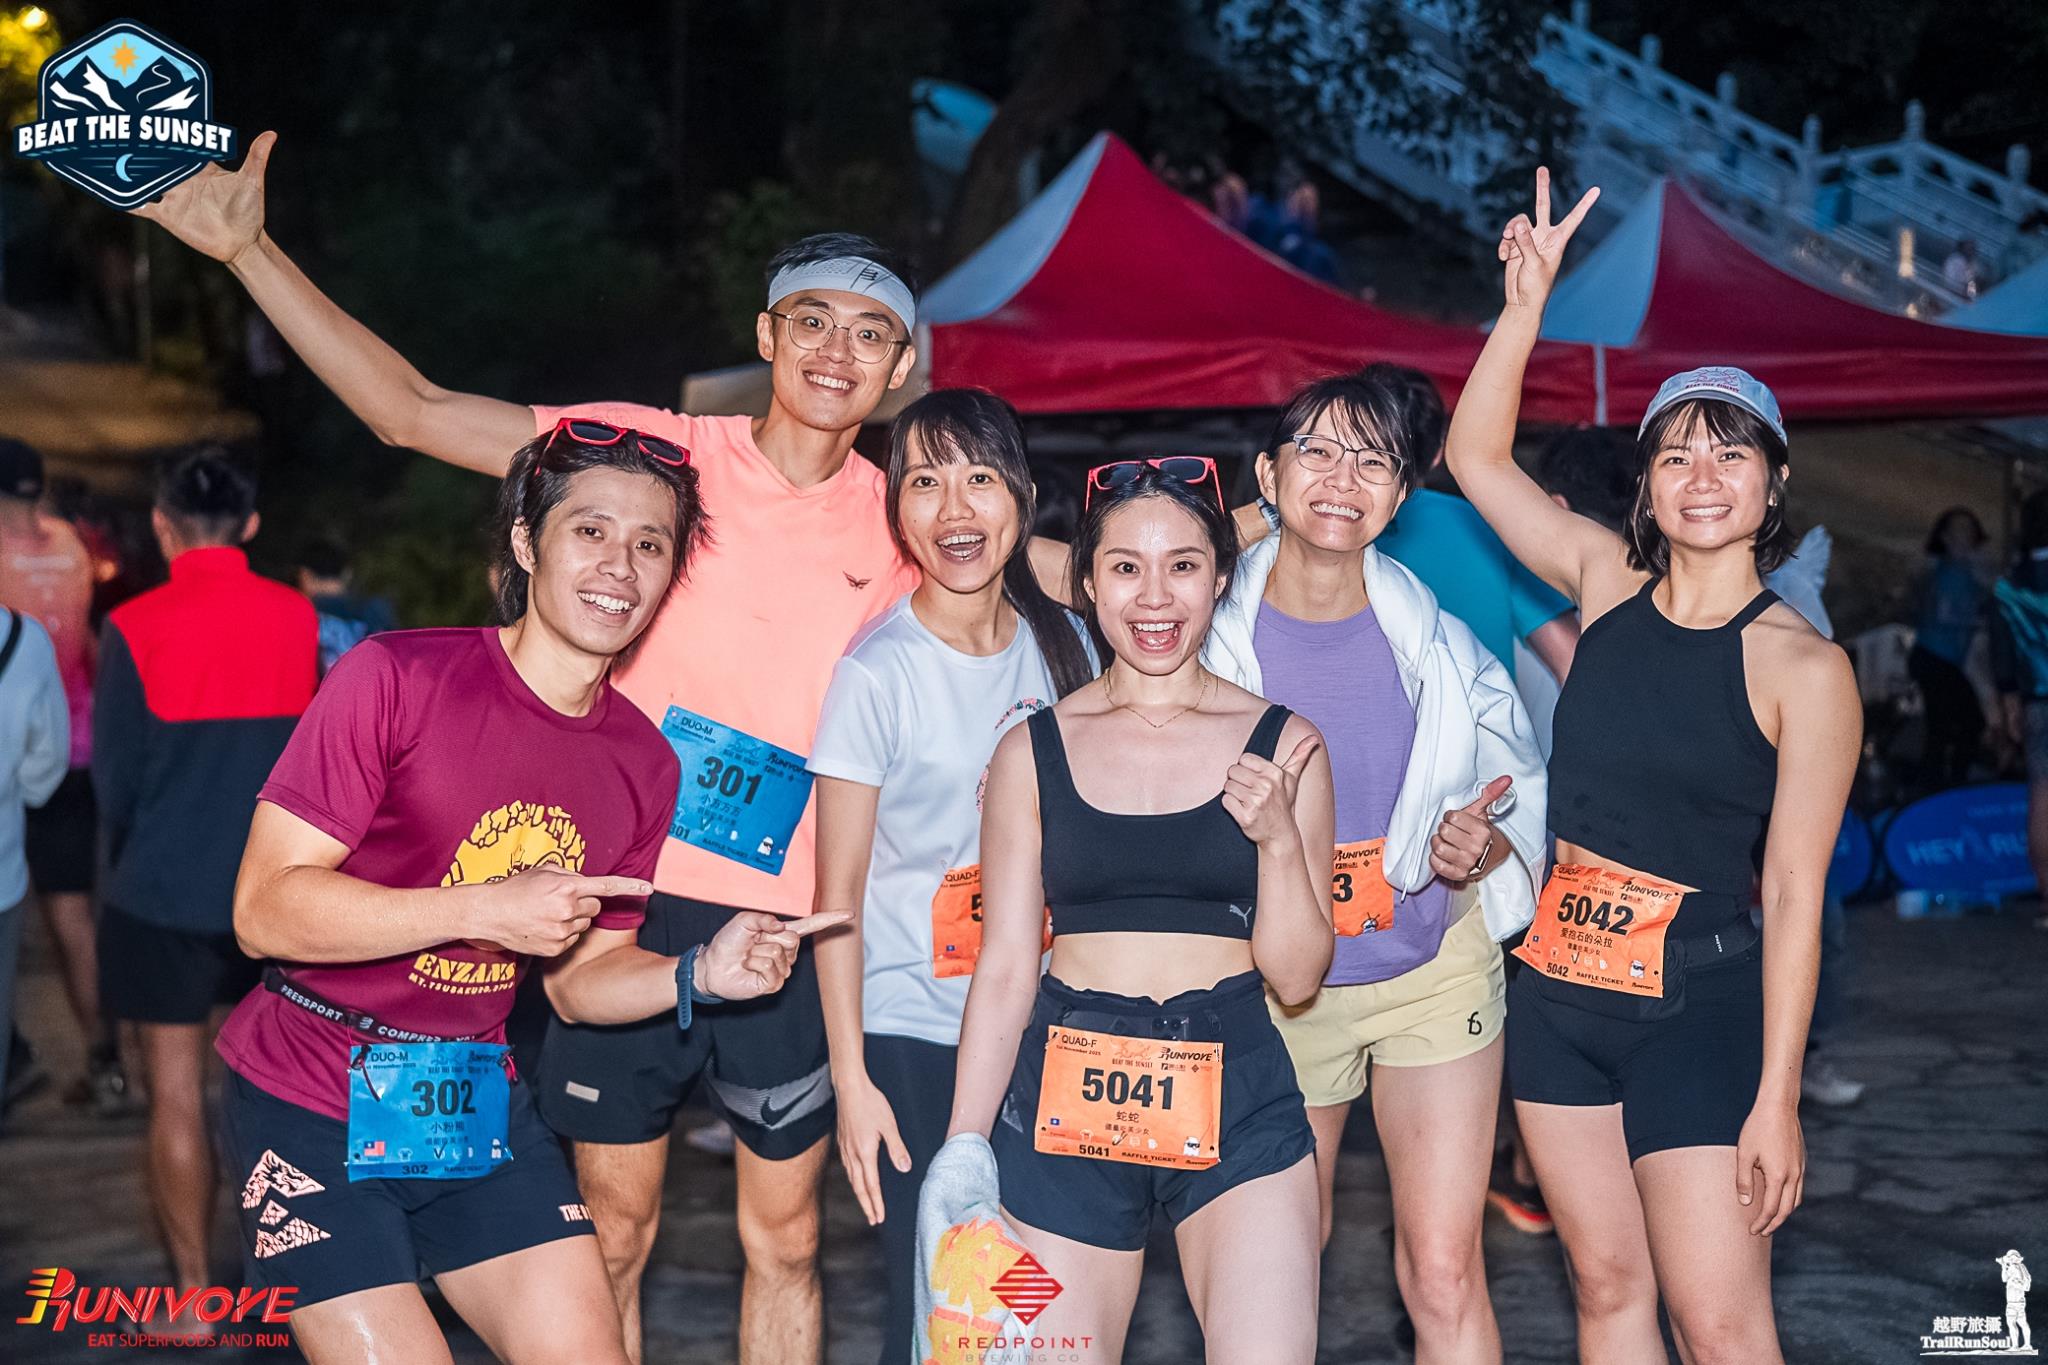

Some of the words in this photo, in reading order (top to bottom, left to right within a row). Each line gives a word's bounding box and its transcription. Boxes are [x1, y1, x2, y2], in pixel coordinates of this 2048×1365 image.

[681, 716, 714, 736] DUO-M
[697, 756, 762, 805] 301
[669, 823, 690, 840] 301
[1332, 873, 1353, 903] 3
[1557, 892, 1634, 936] 5042
[1546, 962, 1569, 978] 5042
[1576, 971, 1600, 981] RAFFLE
[1601, 976, 1625, 986] TICKET
[1061, 1034, 1098, 1048] QUAD-F
[370, 1051, 409, 1063] DUO-M
[1082, 1067, 1174, 1110] 5041
[411, 1079, 477, 1117] 302
[1117, 1111, 1140, 1123] 蛇蛇
[1079, 1144, 1110, 1157] 5041
[1121, 1152, 1148, 1160] RAFFLE
[1151, 1155, 1177, 1163] TICKET
[402, 1165, 429, 1175] 302
[558, 1203, 583, 1222] THE
